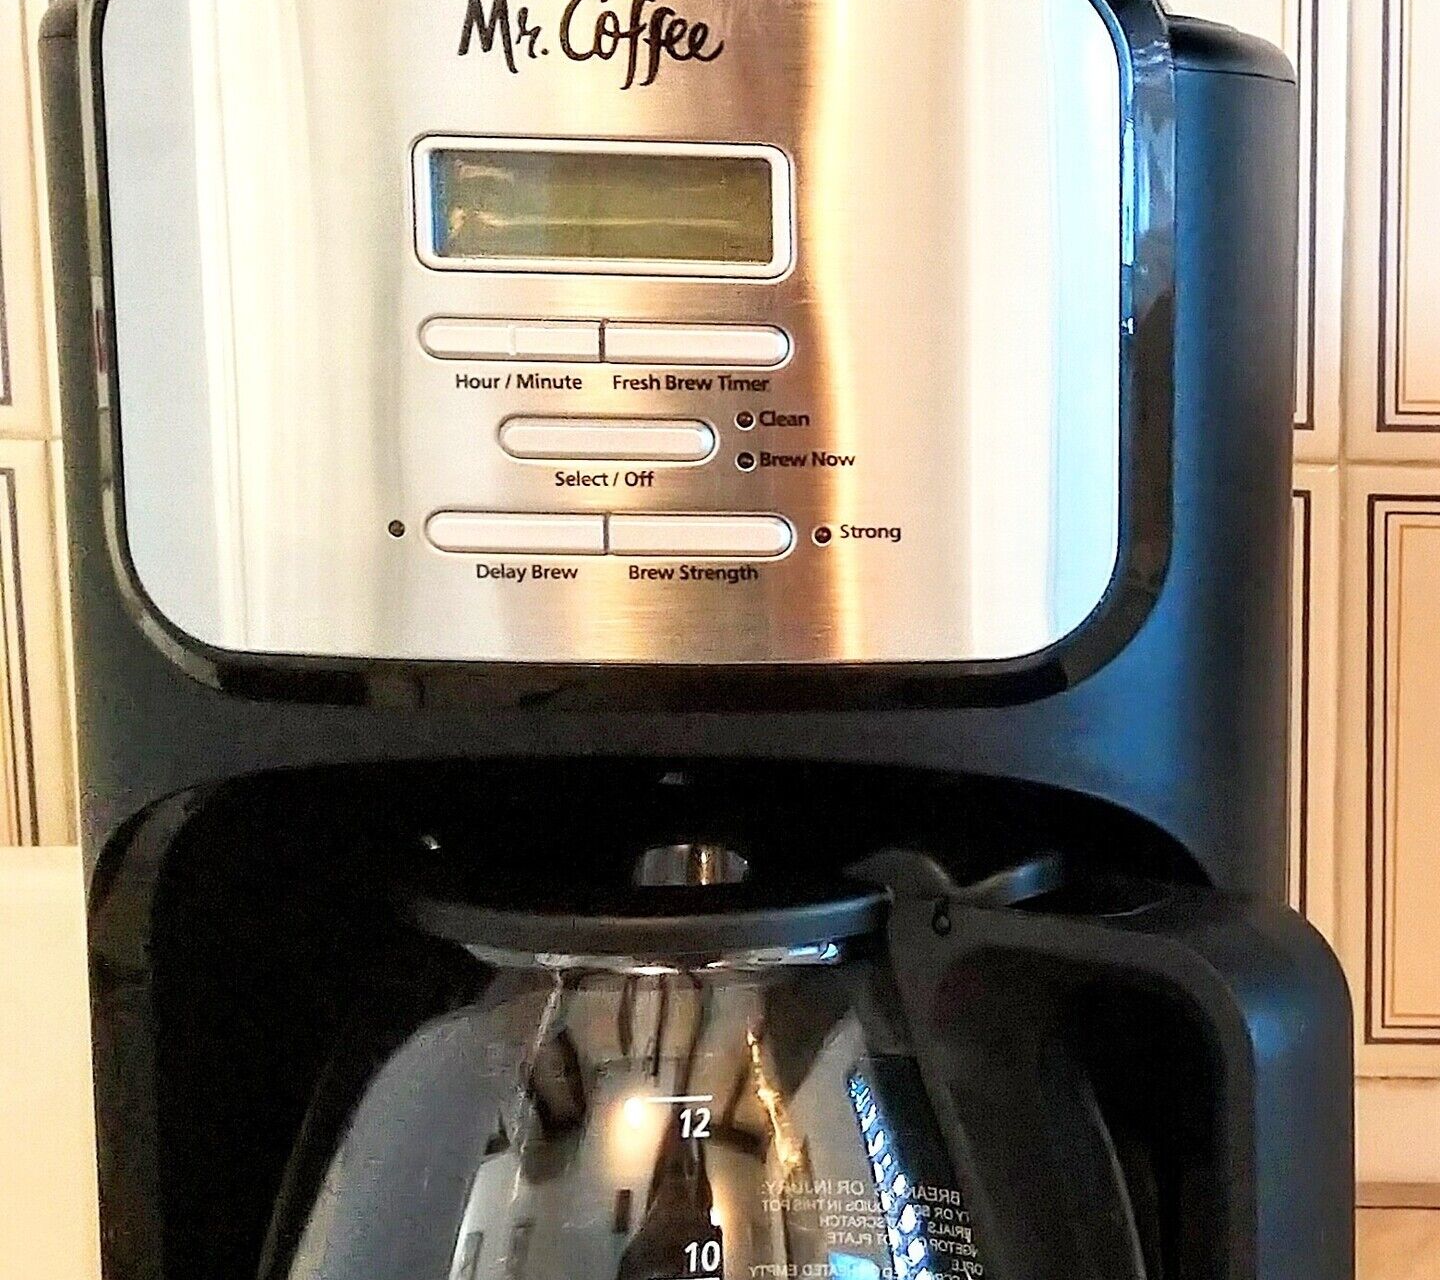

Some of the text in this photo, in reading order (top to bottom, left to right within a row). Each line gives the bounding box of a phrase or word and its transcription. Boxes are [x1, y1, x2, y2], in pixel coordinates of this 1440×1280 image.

[455, 373, 583, 390] Hour / Minute
[612, 374, 770, 392] Fresh Brew Timer
[758, 410, 811, 427] Clean
[759, 451, 856, 468] Brew Now
[555, 471, 655, 488] Select / Off
[840, 524, 902, 543] Strong
[476, 563, 578, 584] Delay Brew
[628, 564, 759, 583] Brew Strength
[679, 1107, 711, 1140] 12
[683, 1240, 722, 1274] 10
